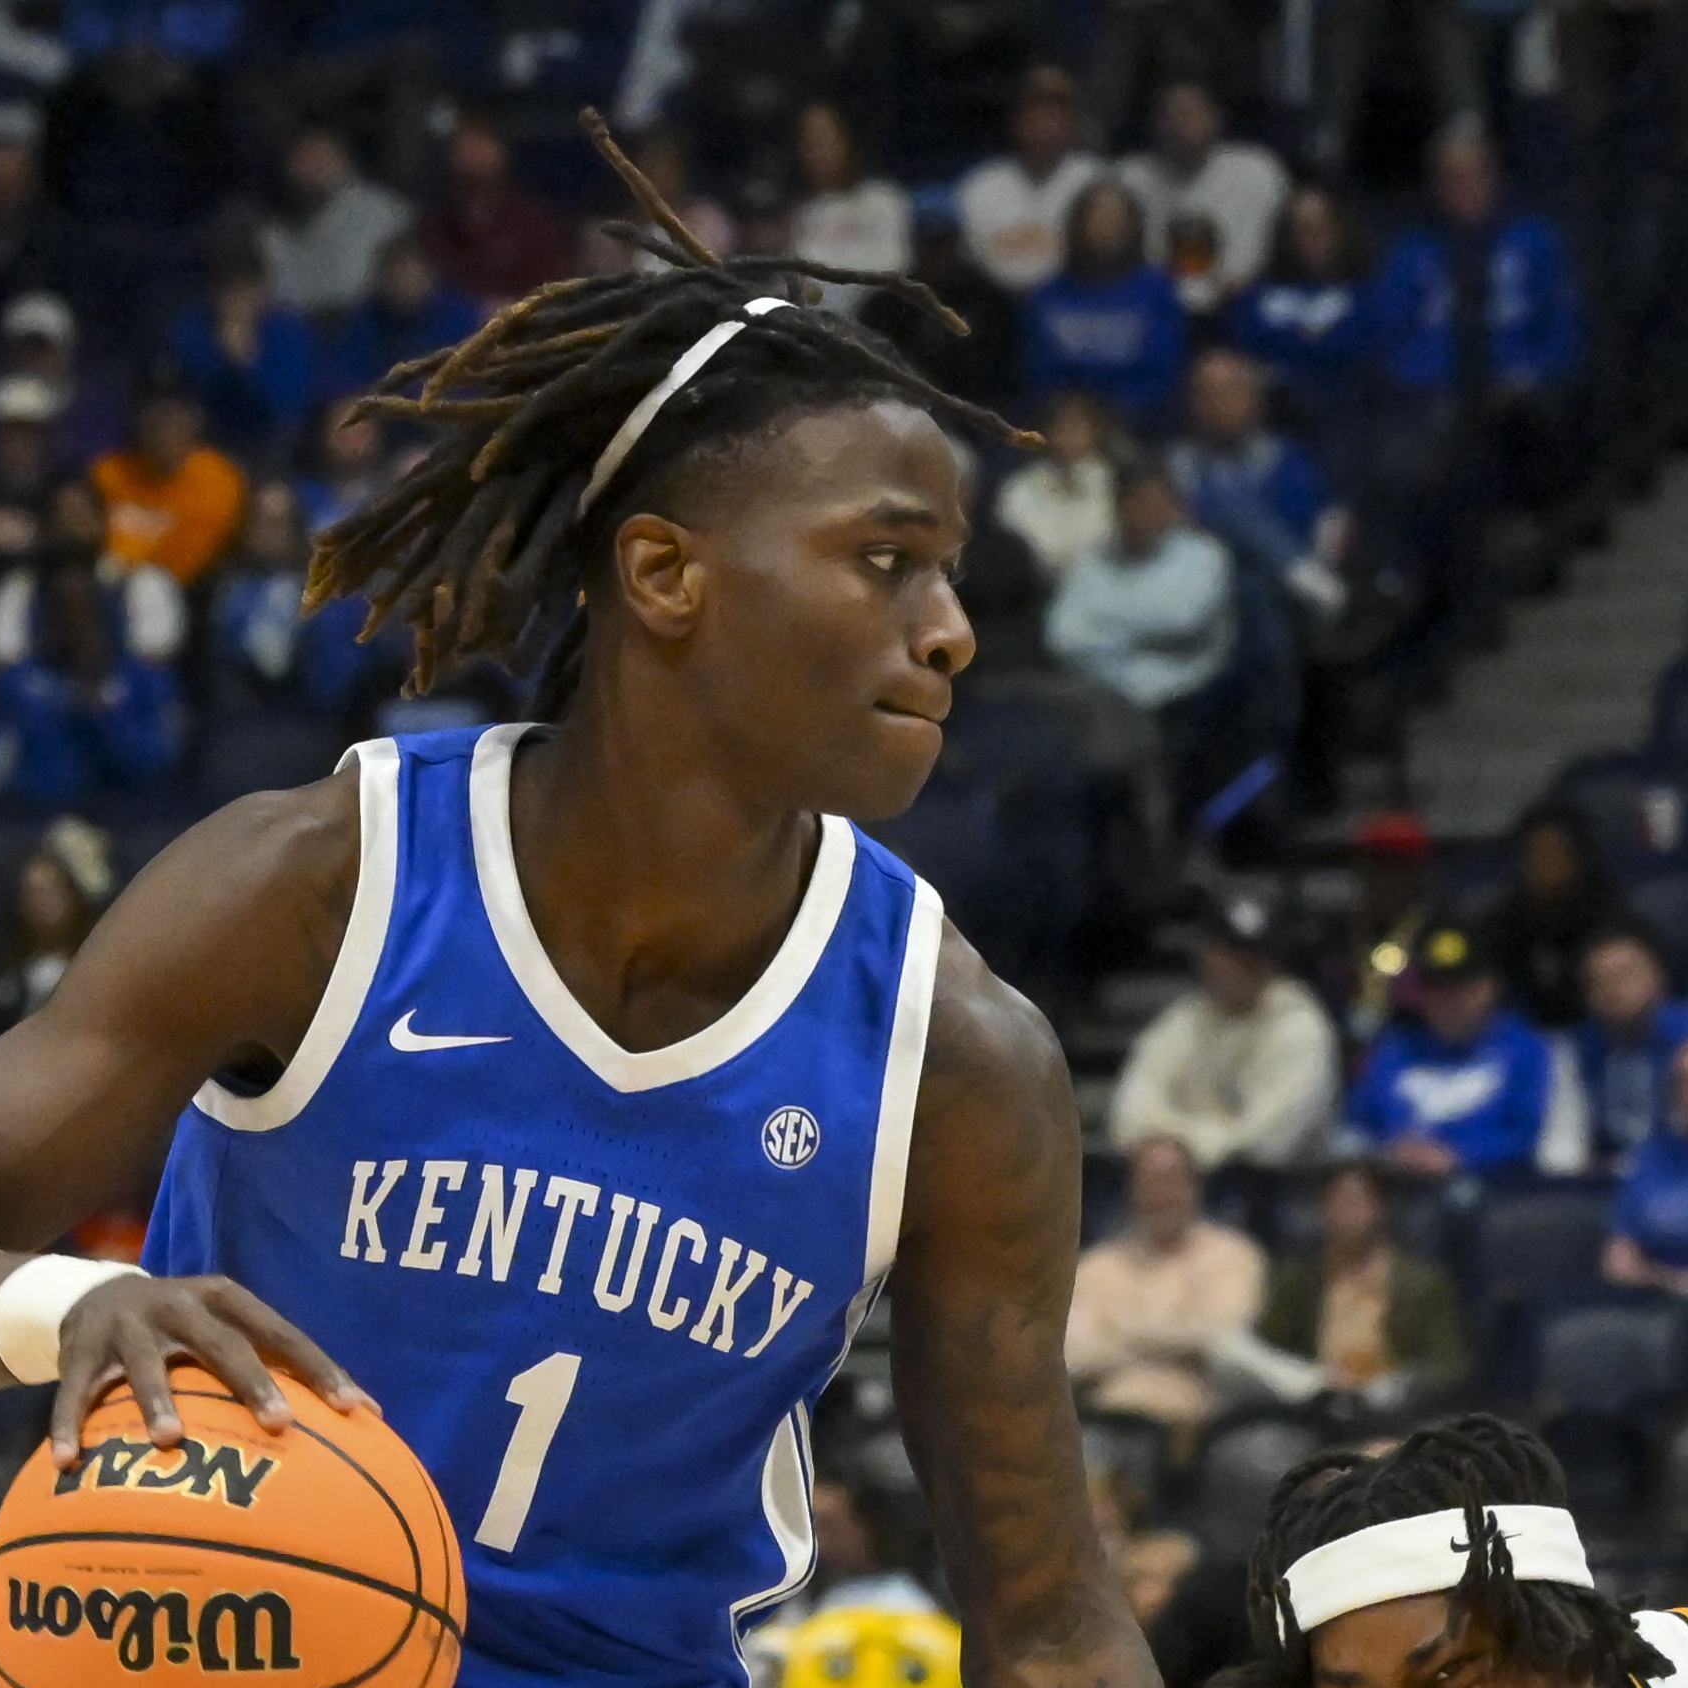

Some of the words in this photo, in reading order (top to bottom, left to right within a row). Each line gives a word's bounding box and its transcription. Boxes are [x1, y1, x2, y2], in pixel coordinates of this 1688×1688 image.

[766, 1110, 816, 1164] SEC
[339, 1158, 815, 1359] KENTUCKY
[473, 1351, 582, 1553] 1
[8, 1575, 301, 1673] Wilson
